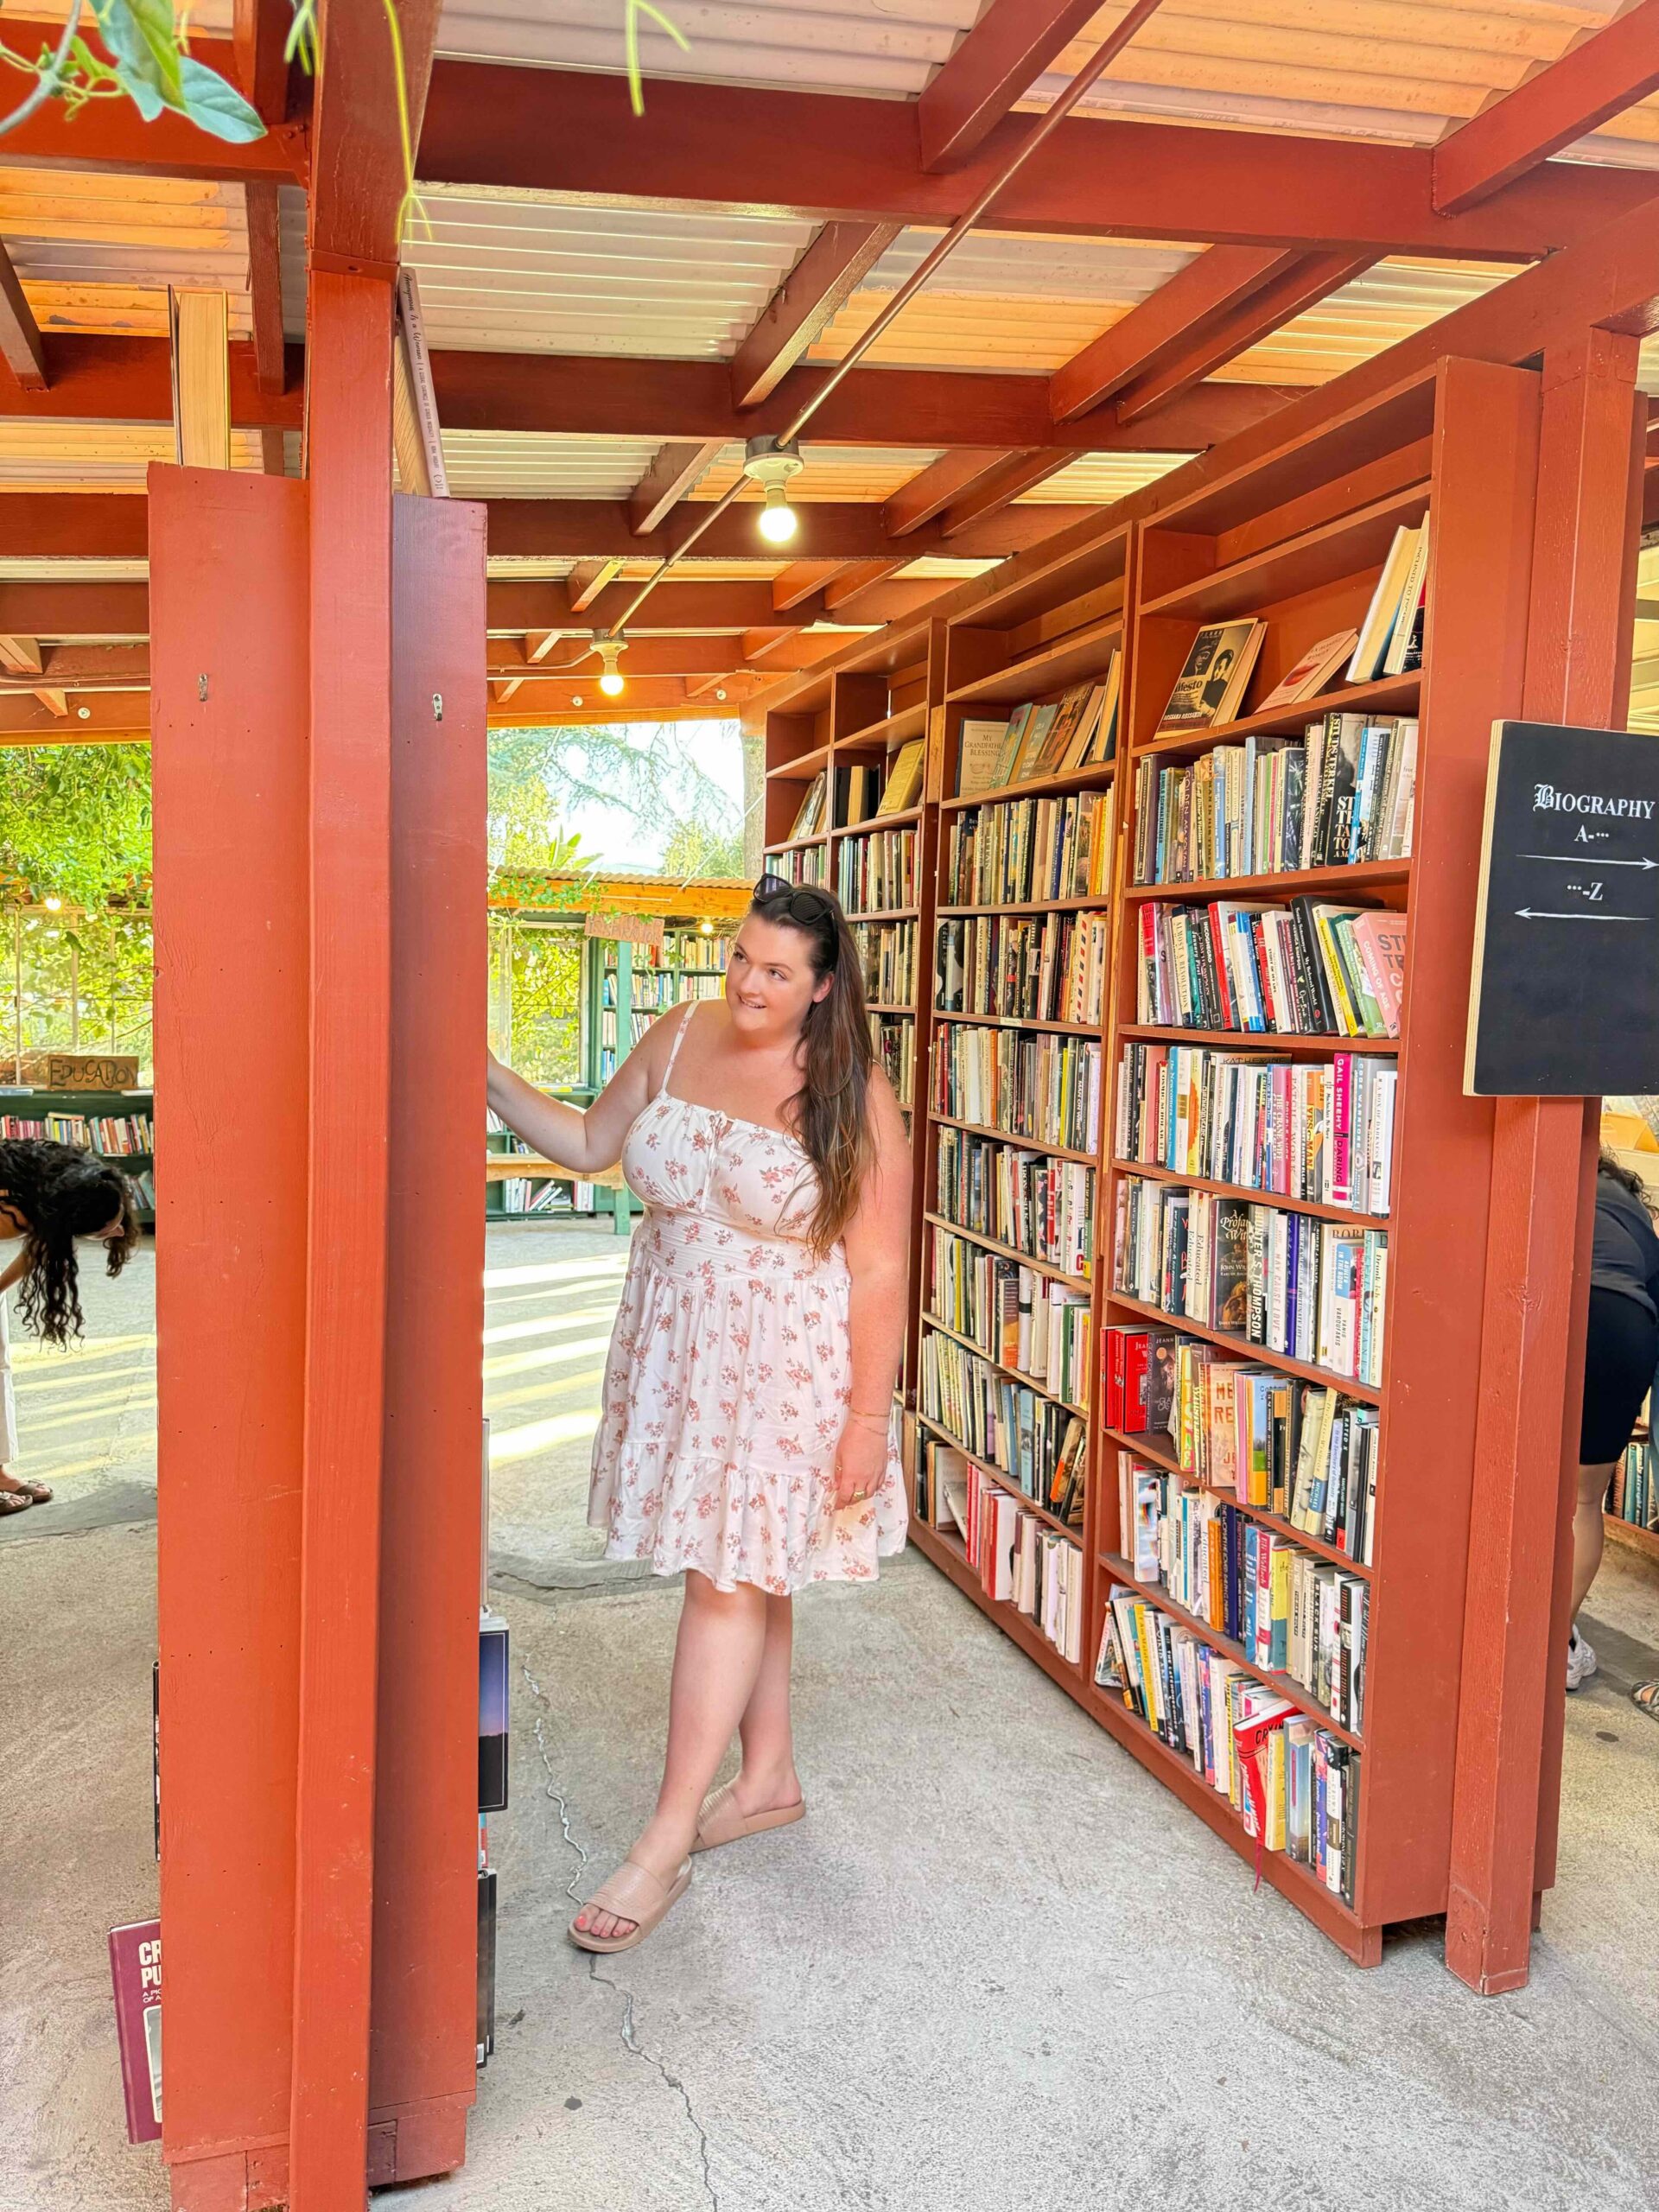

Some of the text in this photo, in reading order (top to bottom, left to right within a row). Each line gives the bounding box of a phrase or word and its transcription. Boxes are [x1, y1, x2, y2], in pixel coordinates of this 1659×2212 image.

[403, 274, 416, 311] Anonymous
[412, 332, 422, 359] Woman
[1406, 546, 1423, 596] INCLINED TO
[1325, 718, 1341, 802] STUDS TERKEL
[1208, 805, 1212, 815] IN
[1313, 823, 1319, 837] GO
[1176, 922, 1185, 950] ALMOST
[1204, 921, 1212, 963] INCOGNEGRO
[1297, 924, 1307, 953] Sotomayor
[1305, 957, 1311, 965] My
[1363, 940, 1390, 1010] COMING OF AGE
[1179, 962, 1190, 1008] REVOLUTION
[1270, 973, 1275, 982] MY
[1306, 966, 1315, 988] Beloved
[49, 1059, 138, 1088] EDUCATION
[1223, 1057, 1287, 1065] KATHERINE
[1077, 1098, 1082, 1110] ON
[1335, 1058, 1344, 1130] GAIL SHEEHY
[1376, 1109, 1382, 1120] OF
[1335, 1141, 1344, 1183] DARING
[1230, 1210, 1237, 1219] A
[1195, 1235, 1205, 1286] Educated
[1251, 1211, 1263, 1338] HUNTER S. THOMPSON
[1272, 1308, 1281, 1339] LOVE
[1313, 1481, 1321, 1509] MICHAEL
[1613, 1484, 1623, 1508] FINCH
[1259, 1553, 1268, 1585] Wallach
